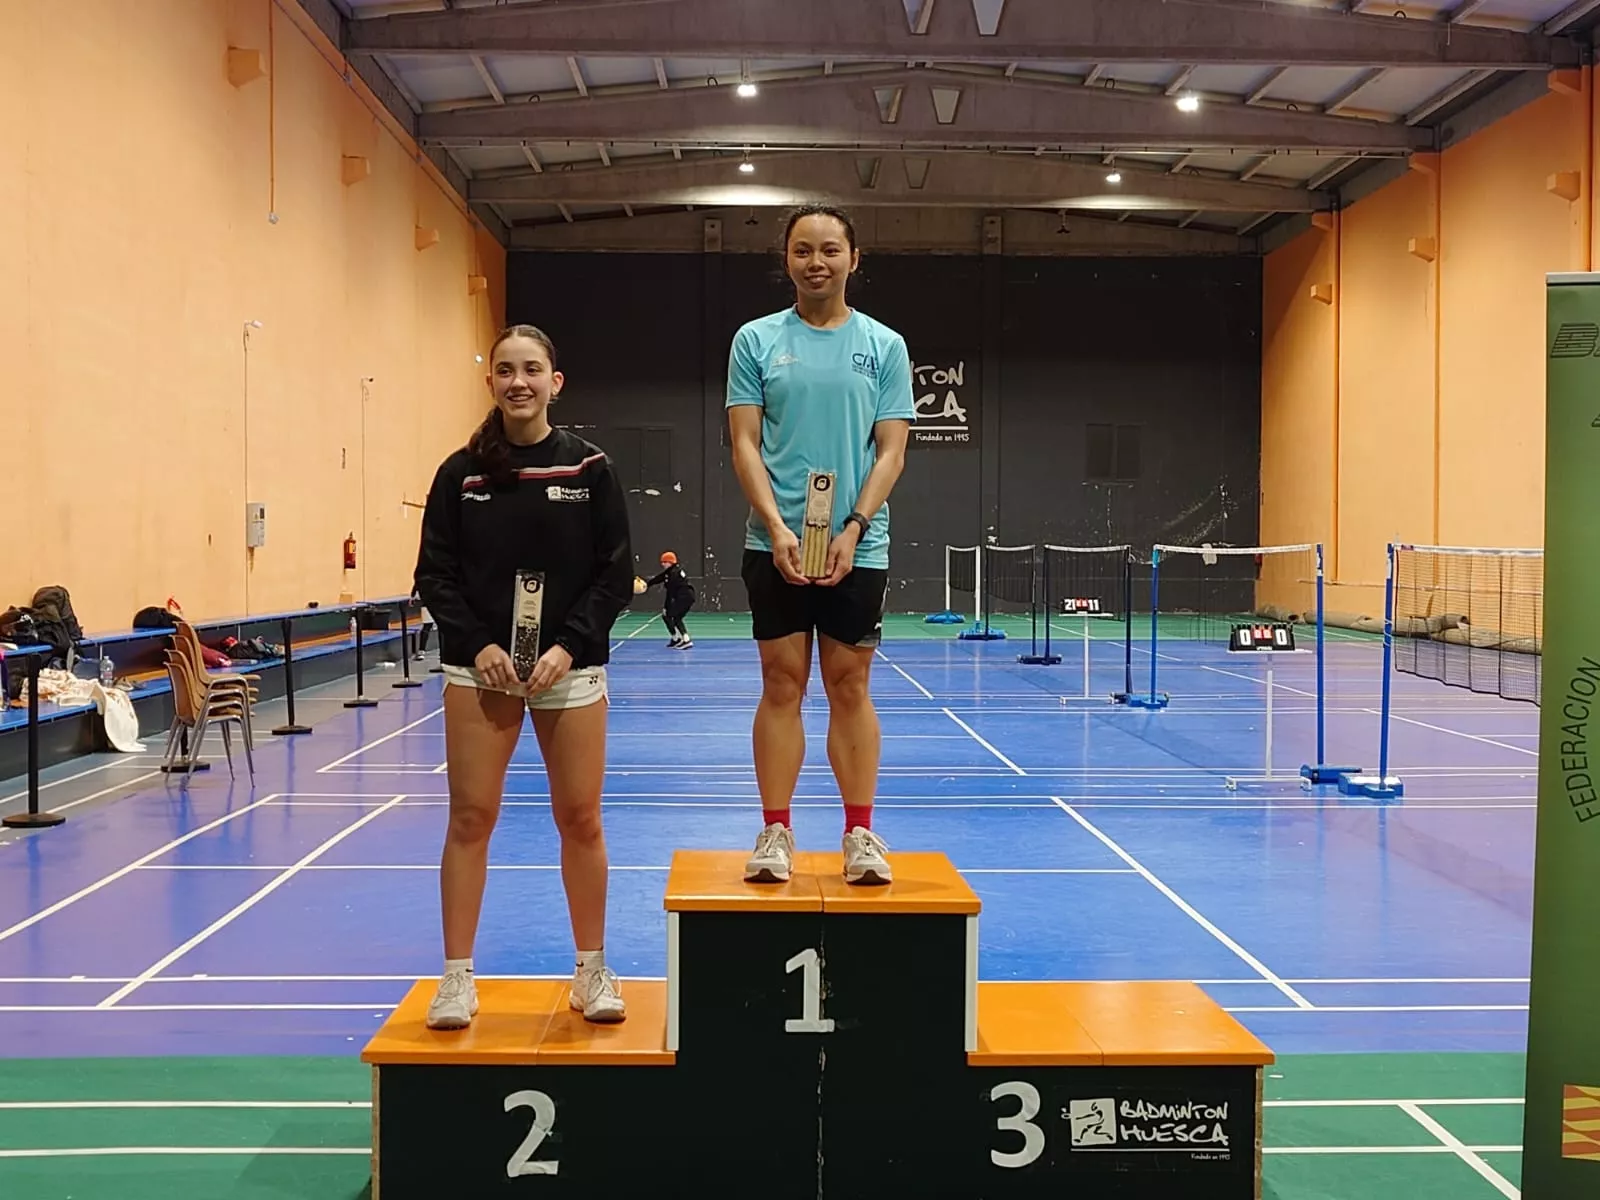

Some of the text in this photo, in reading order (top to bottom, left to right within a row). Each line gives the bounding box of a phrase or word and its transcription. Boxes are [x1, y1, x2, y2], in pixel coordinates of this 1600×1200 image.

[915, 432, 943, 441] Fundado
[1064, 599, 1076, 610] 21
[1088, 599, 1099, 610] 11
[1240, 628, 1251, 645] 0
[1275, 628, 1287, 645] 0
[785, 948, 835, 1033] 1
[503, 1089, 560, 1178] 2
[990, 1081, 1045, 1168] 3
[1119, 1122, 1229, 1146] HUESCA
